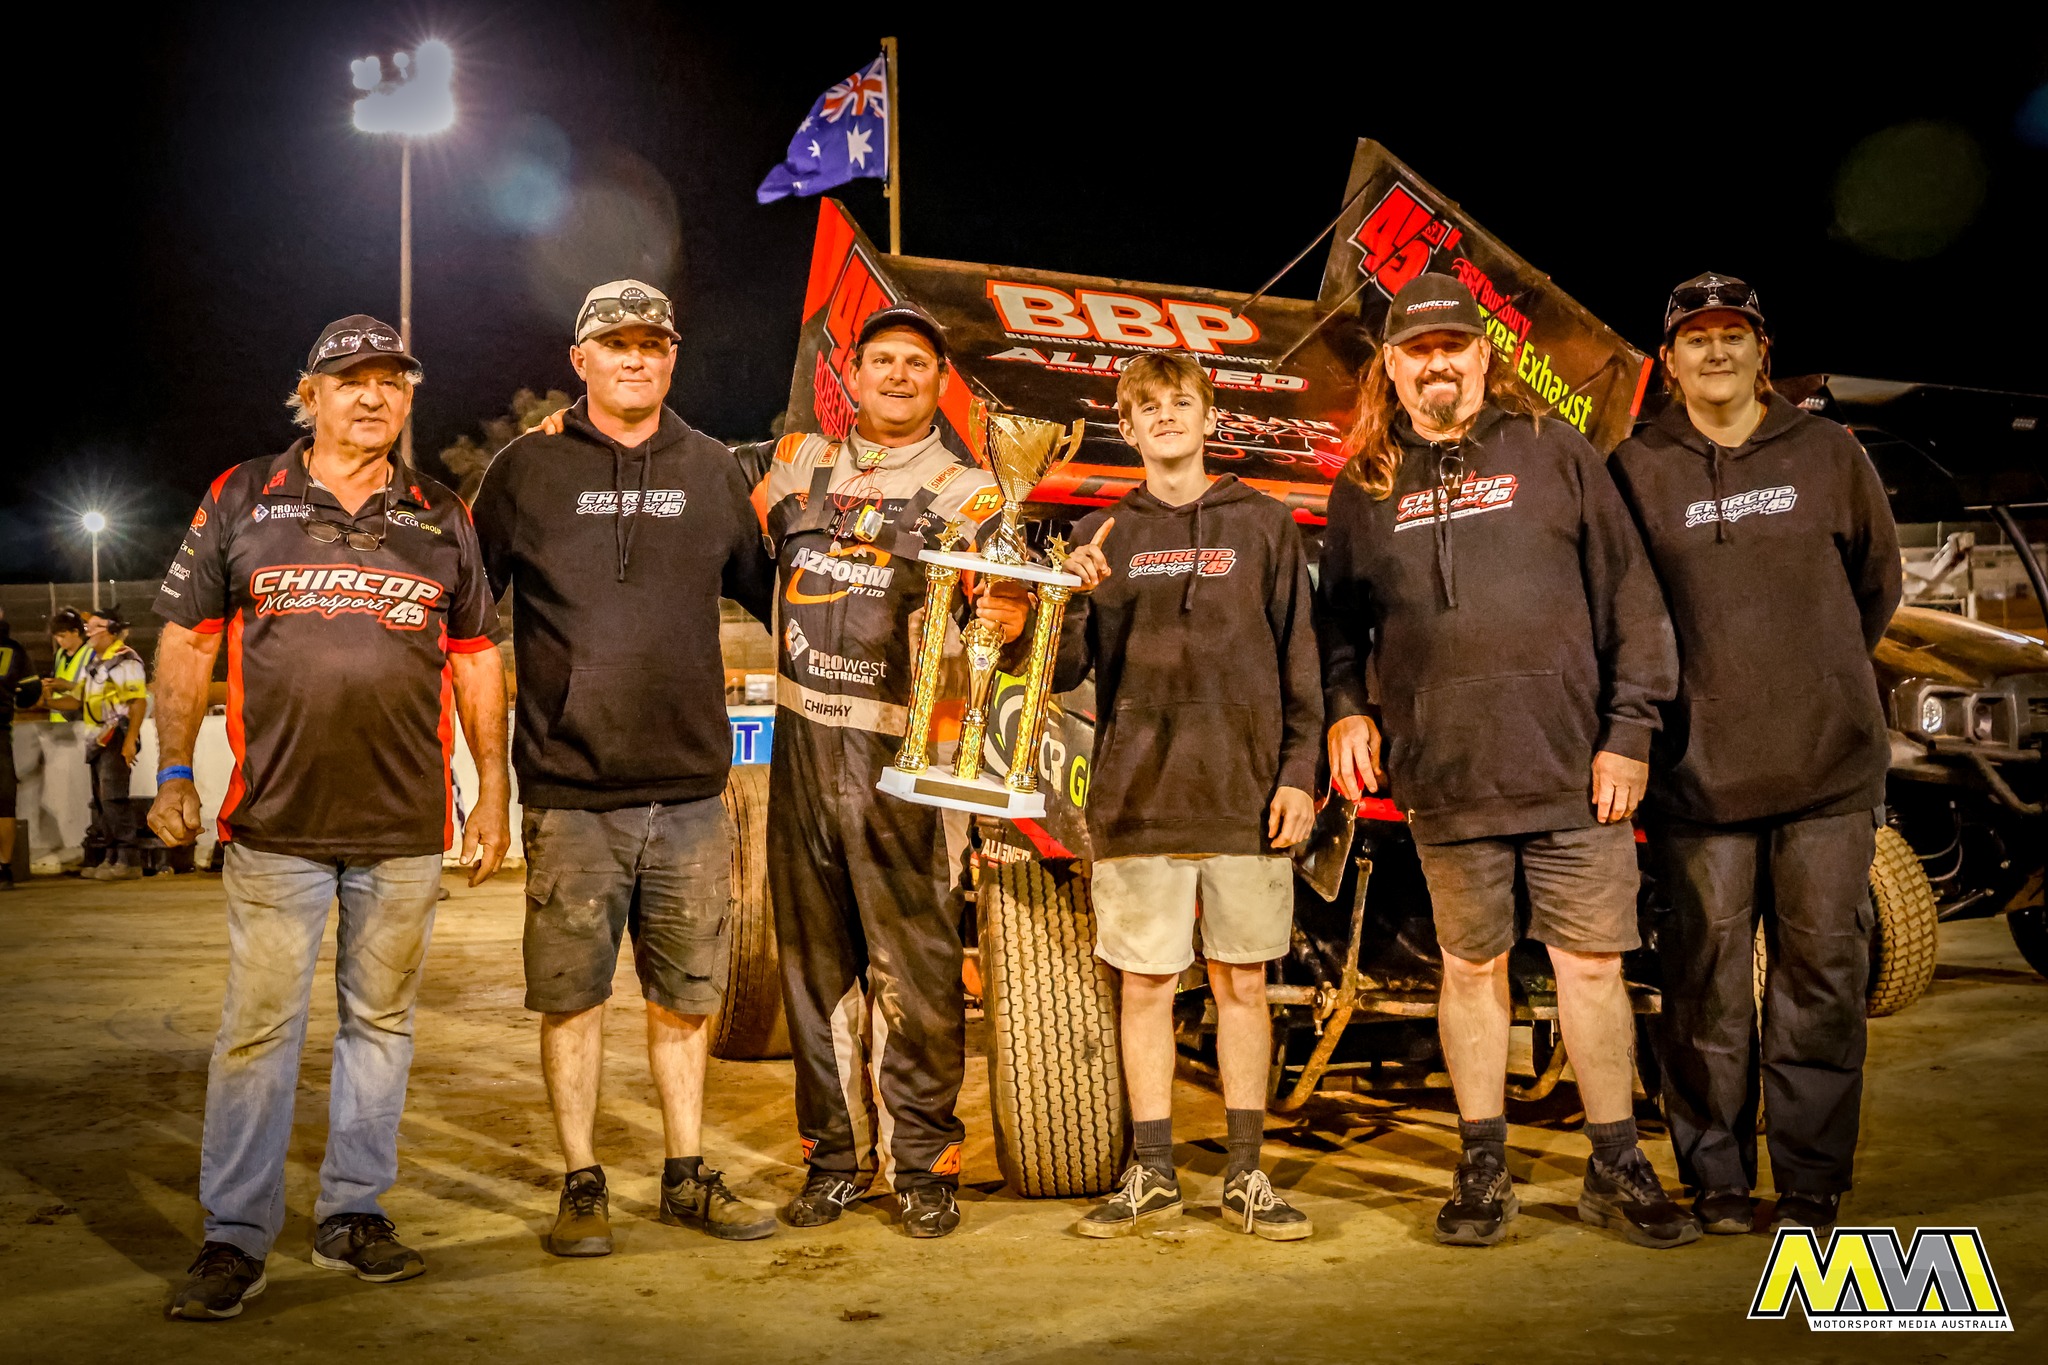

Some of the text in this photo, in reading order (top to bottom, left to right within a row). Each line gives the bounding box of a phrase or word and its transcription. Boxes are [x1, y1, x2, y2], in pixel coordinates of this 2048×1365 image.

[1406, 299, 1460, 312] CHIRCOP
[988, 281, 1259, 353] BBP
[1004, 332, 1106, 348] BUSSELTON
[985, 347, 1312, 391] ALIED
[1517, 340, 1593, 434] Exhaust
[930, 465, 959, 492] SIMPSON
[1480, 487, 1513, 504] 45
[1688, 488, 1792, 515] CHIRCOP
[1764, 497, 1793, 512] 45
[657, 501, 682, 515] 45
[404, 517, 442, 535] CCR GROUP
[790, 547, 895, 588] AZFORM
[1131, 549, 1233, 567] CHIRCOP
[1202, 560, 1233, 574] 45
[253, 569, 440, 600] CHIRCOP
[846, 585, 886, 598] PTY LTD
[259, 592, 426, 625] Motorsport 45
[807, 665, 875, 686] ELECTRICAL
